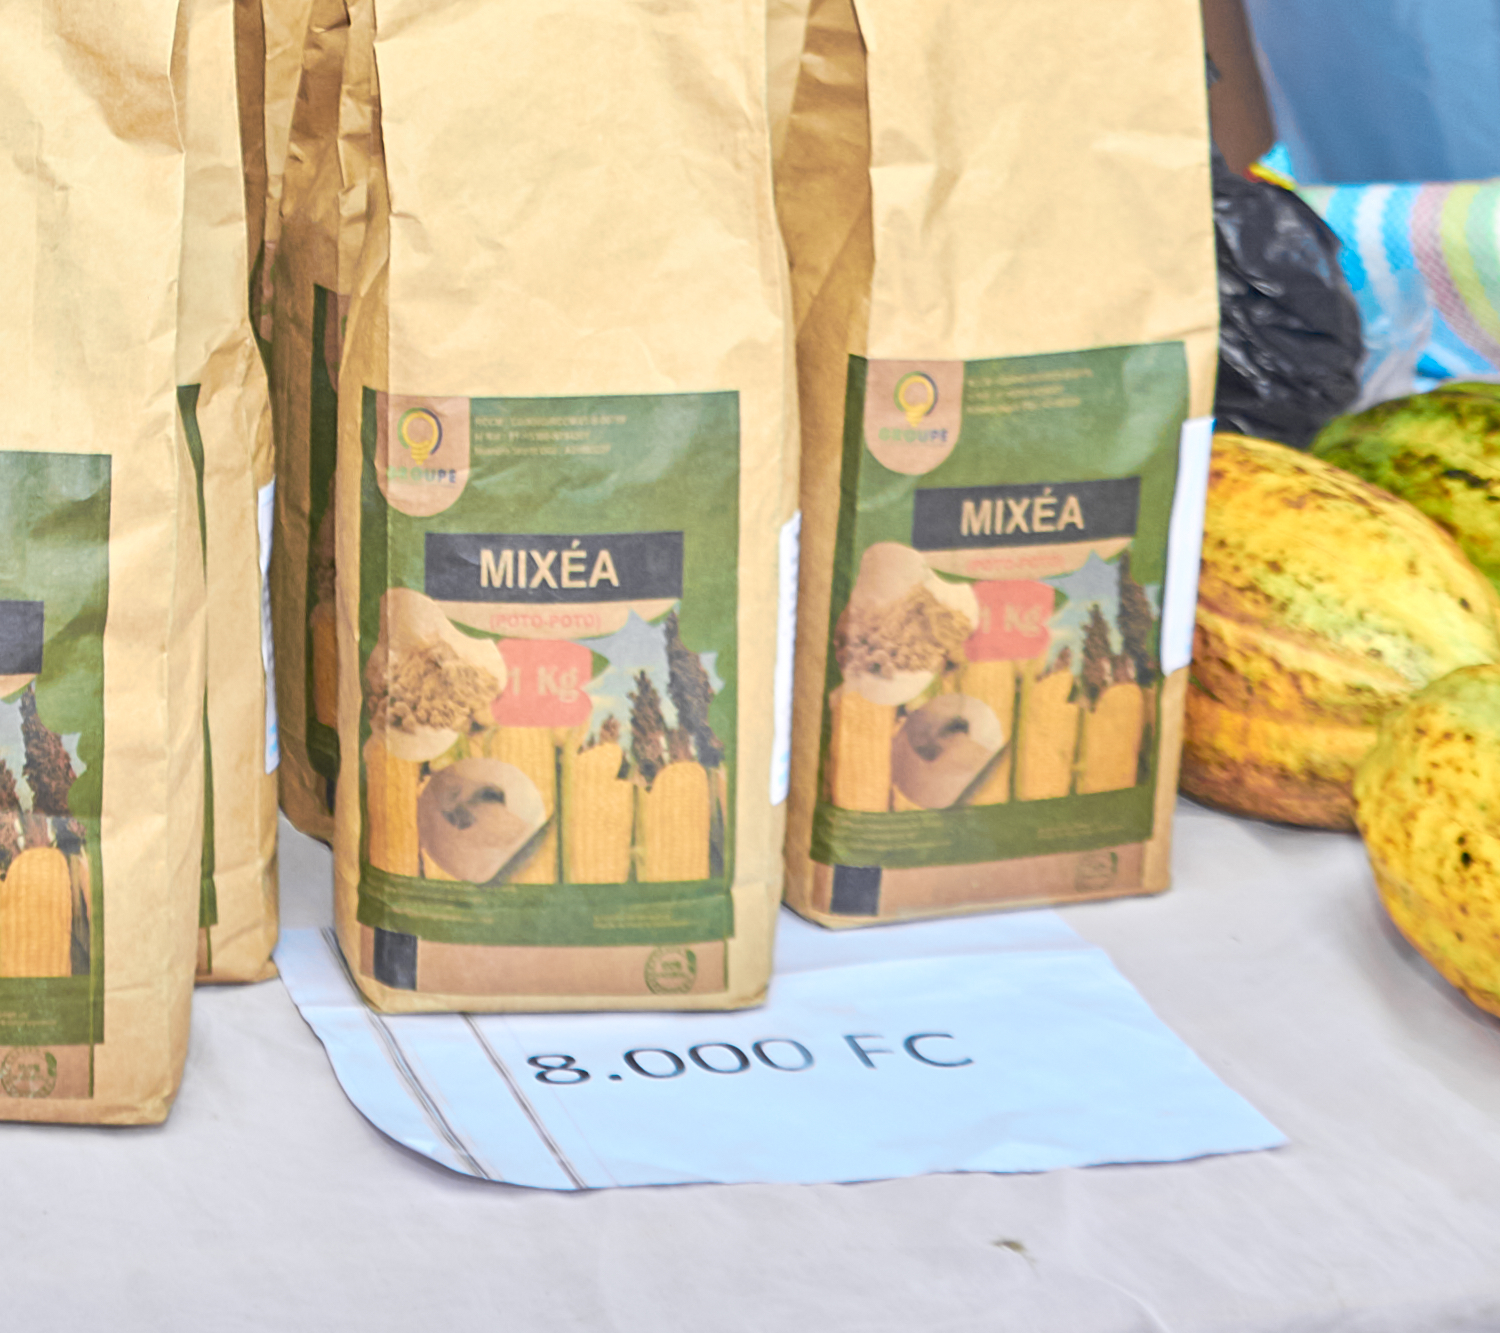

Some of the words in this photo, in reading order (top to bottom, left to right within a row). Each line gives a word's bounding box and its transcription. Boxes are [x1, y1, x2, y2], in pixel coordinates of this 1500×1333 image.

[960, 486, 1085, 537] MIXÉA
[479, 538, 620, 590] MIXÉA
[536, 666, 580, 704] Kg
[526, 1037, 816, 1086] 8.000
[842, 1031, 976, 1071] FC
